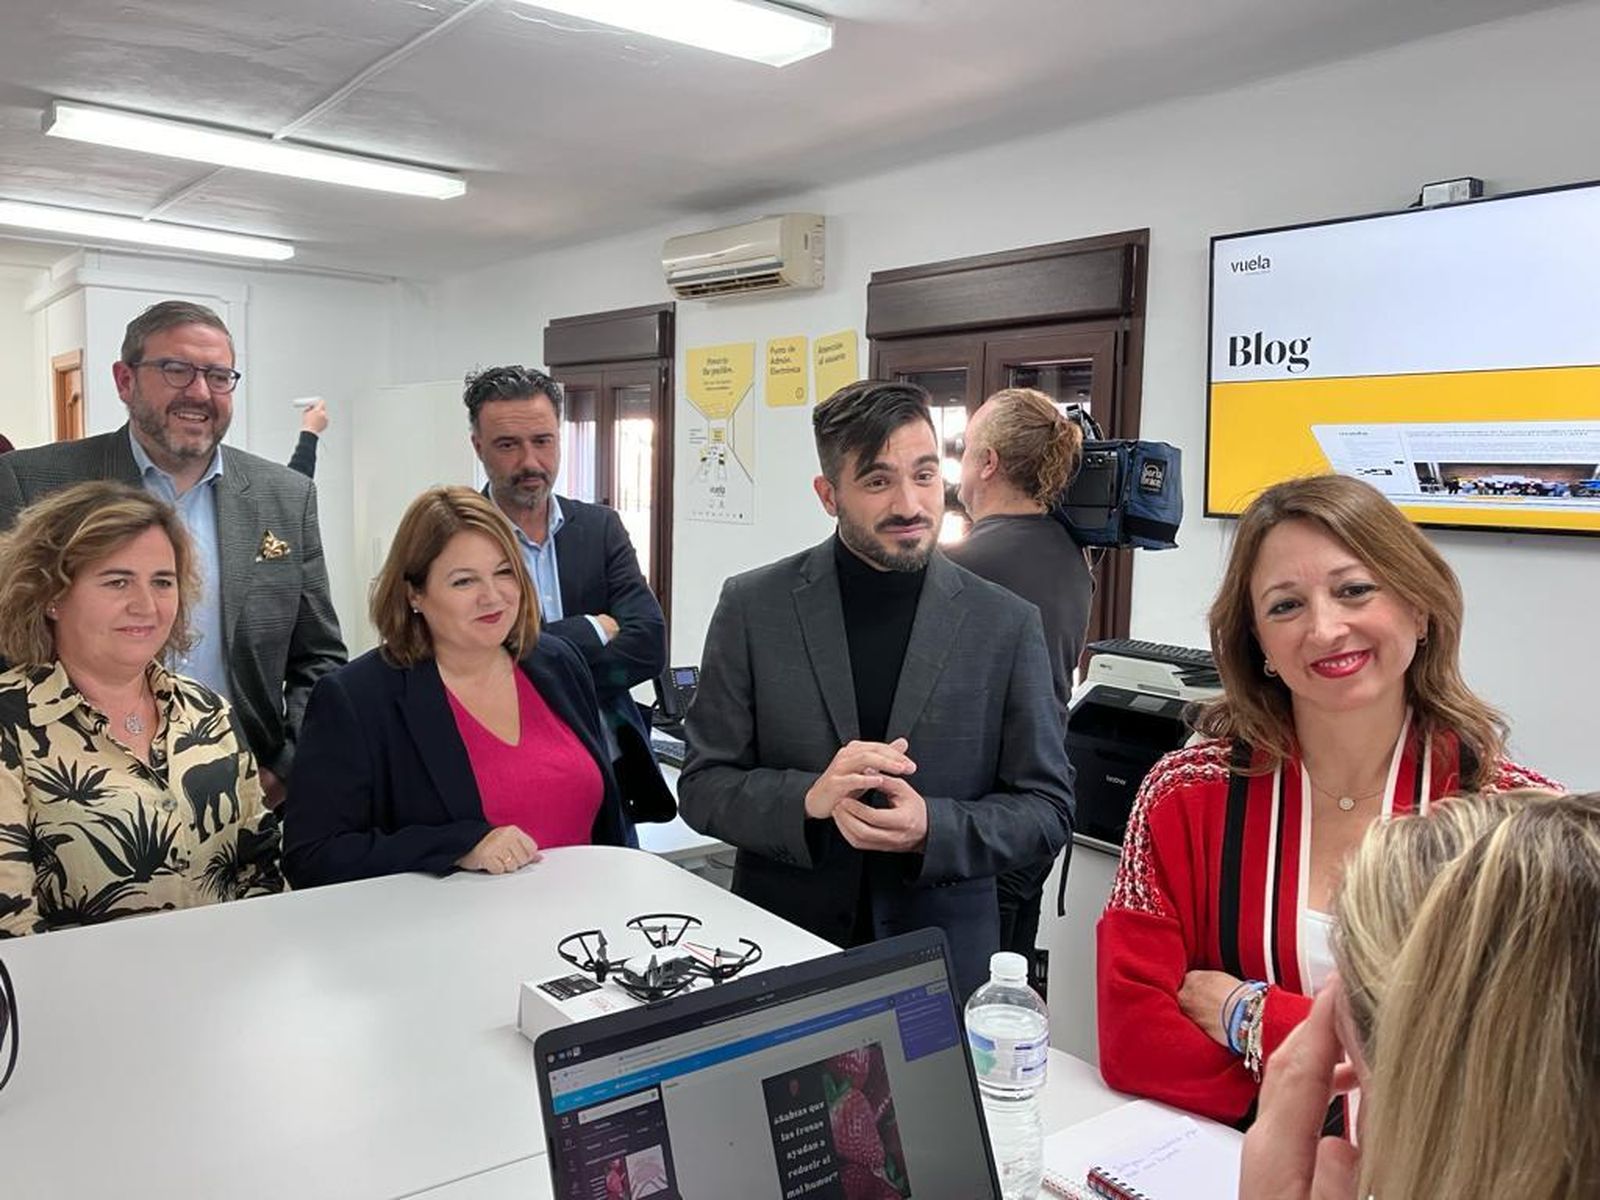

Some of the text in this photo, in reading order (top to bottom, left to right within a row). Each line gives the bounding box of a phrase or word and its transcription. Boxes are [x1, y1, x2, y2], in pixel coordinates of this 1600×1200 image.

[1230, 254, 1271, 273] vuela
[1229, 331, 1312, 374] Blog
[808, 1101, 825, 1113] que
[780, 1121, 824, 1142] las fresas
[786, 1139, 827, 1160] ayudan a
[788, 1160, 821, 1179] reducir
[786, 1183, 804, 1199] mal
